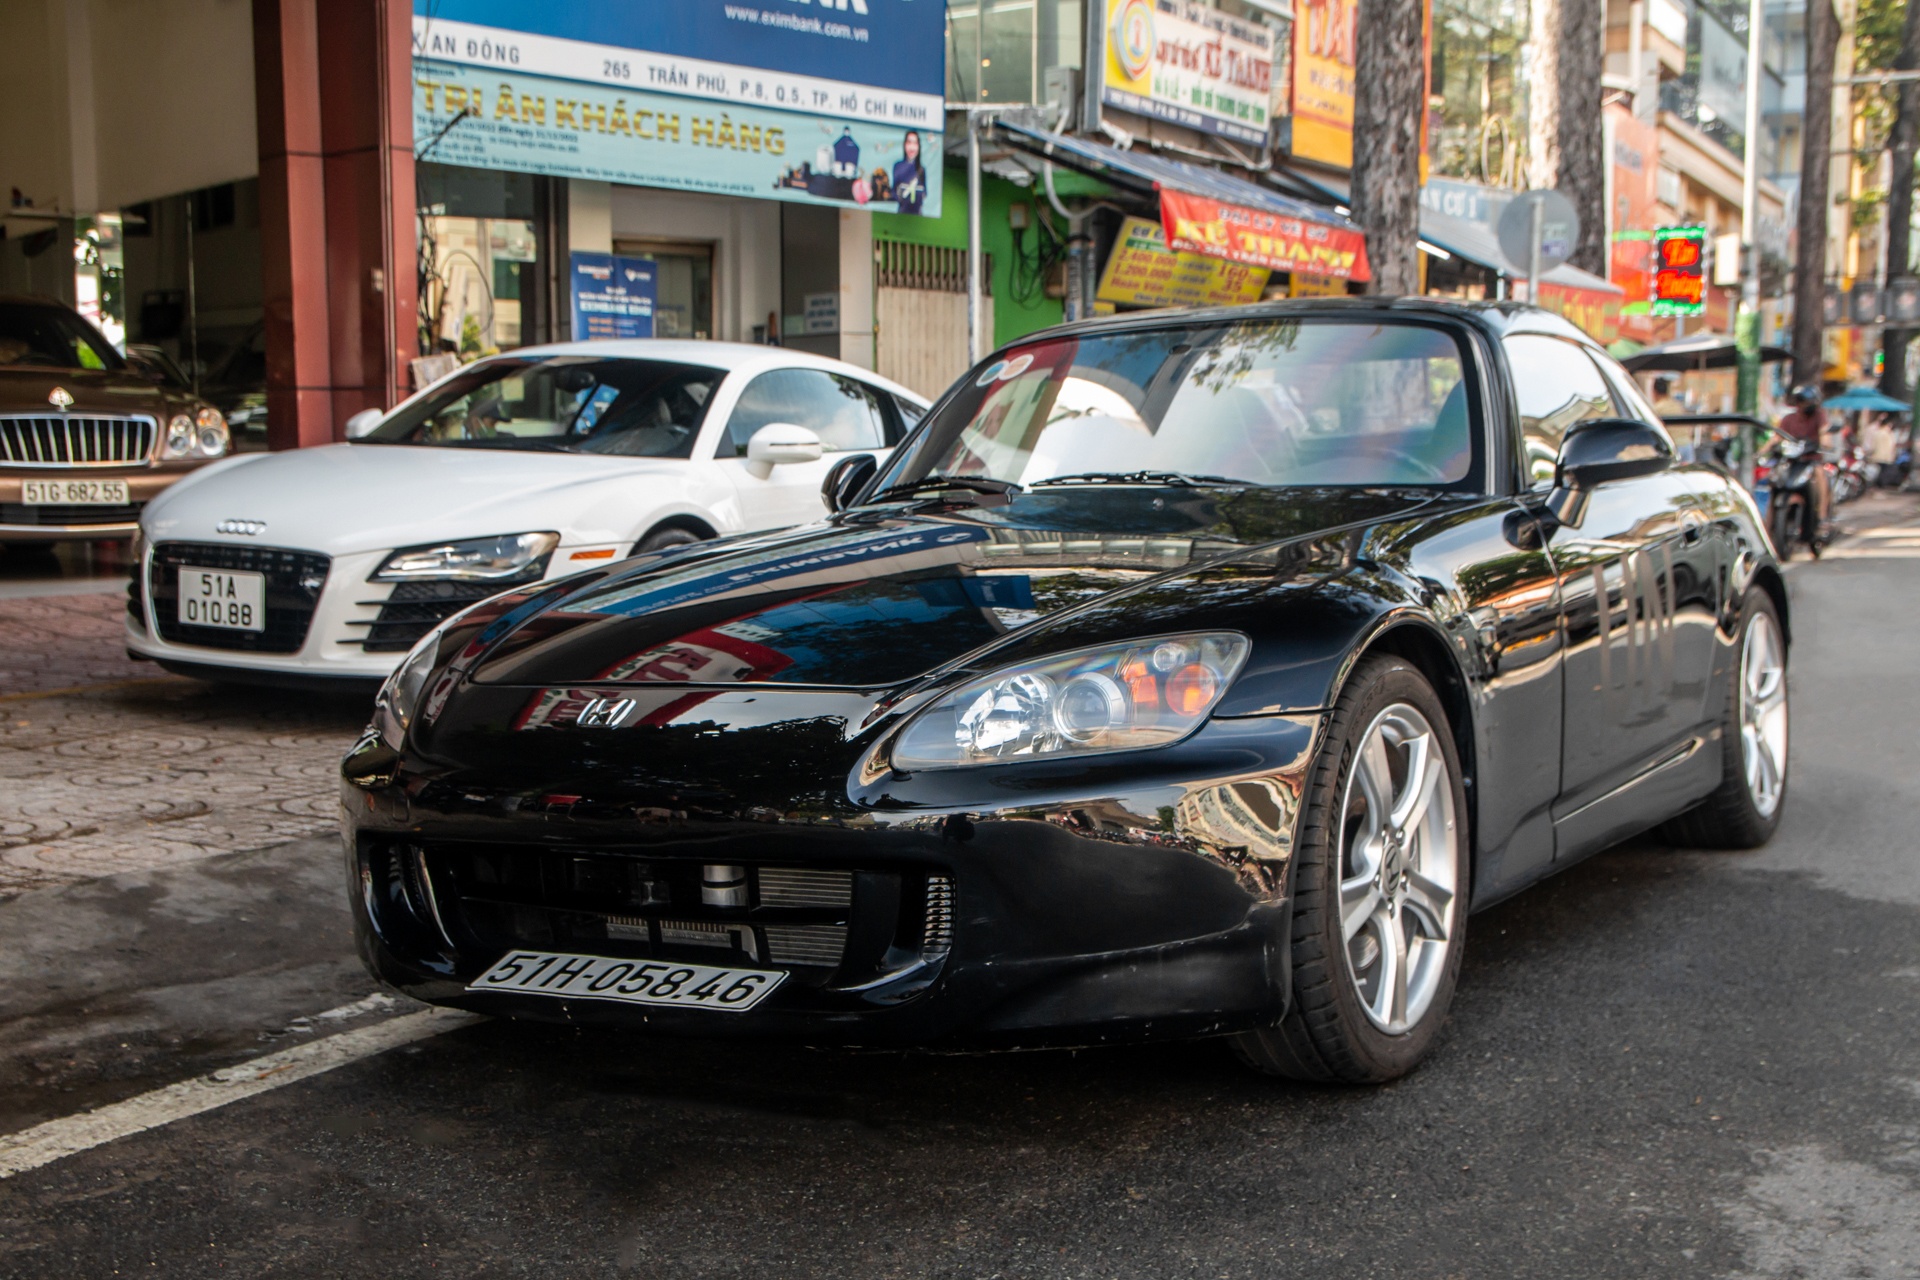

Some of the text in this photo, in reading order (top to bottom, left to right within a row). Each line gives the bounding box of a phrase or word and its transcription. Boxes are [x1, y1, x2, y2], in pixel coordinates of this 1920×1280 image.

[725, 4, 869, 42] www.eximbank.com.vn
[432, 35, 456, 54] AN
[467, 38, 520, 64] ĐÔNG
[603, 60, 631, 79] 265
[894, 102, 927, 121] MINH
[417, 79, 482, 117] TRI
[494, 82, 546, 125] ÂN
[555, 99, 680, 144] KHÁCH
[691, 112, 786, 156] HÀNG
[202, 574, 237, 599] 51A
[187, 599, 252, 626] 010.88
[487, 954, 766, 1004] 51H-058.46
